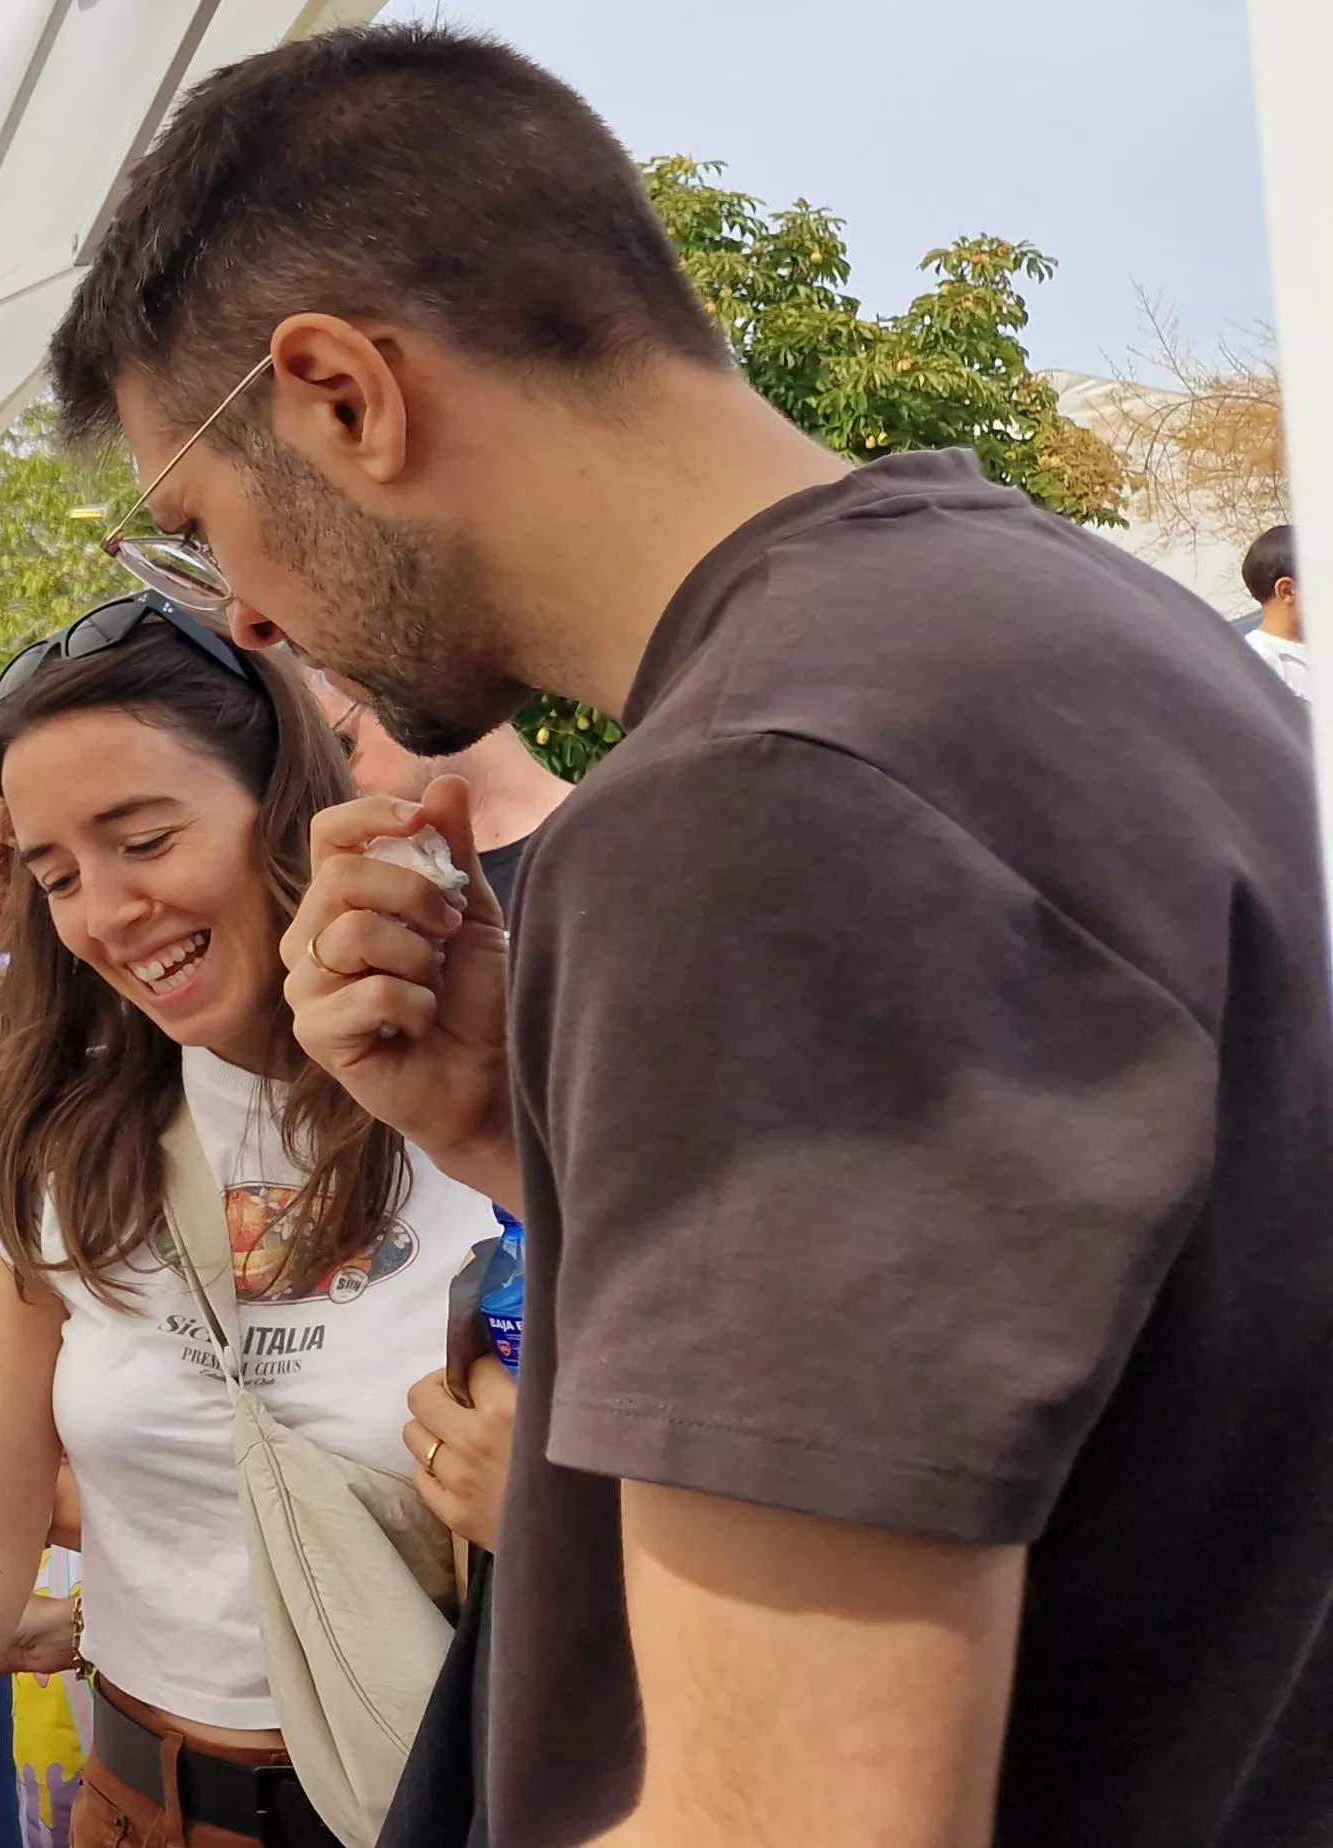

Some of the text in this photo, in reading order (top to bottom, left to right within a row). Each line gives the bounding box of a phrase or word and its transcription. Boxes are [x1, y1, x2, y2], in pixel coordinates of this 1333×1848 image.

[488, 1317, 515, 1333] BAJA
[242, 1324, 326, 1356] ITALIA
[255, 1358, 302, 1376] CITRUS
